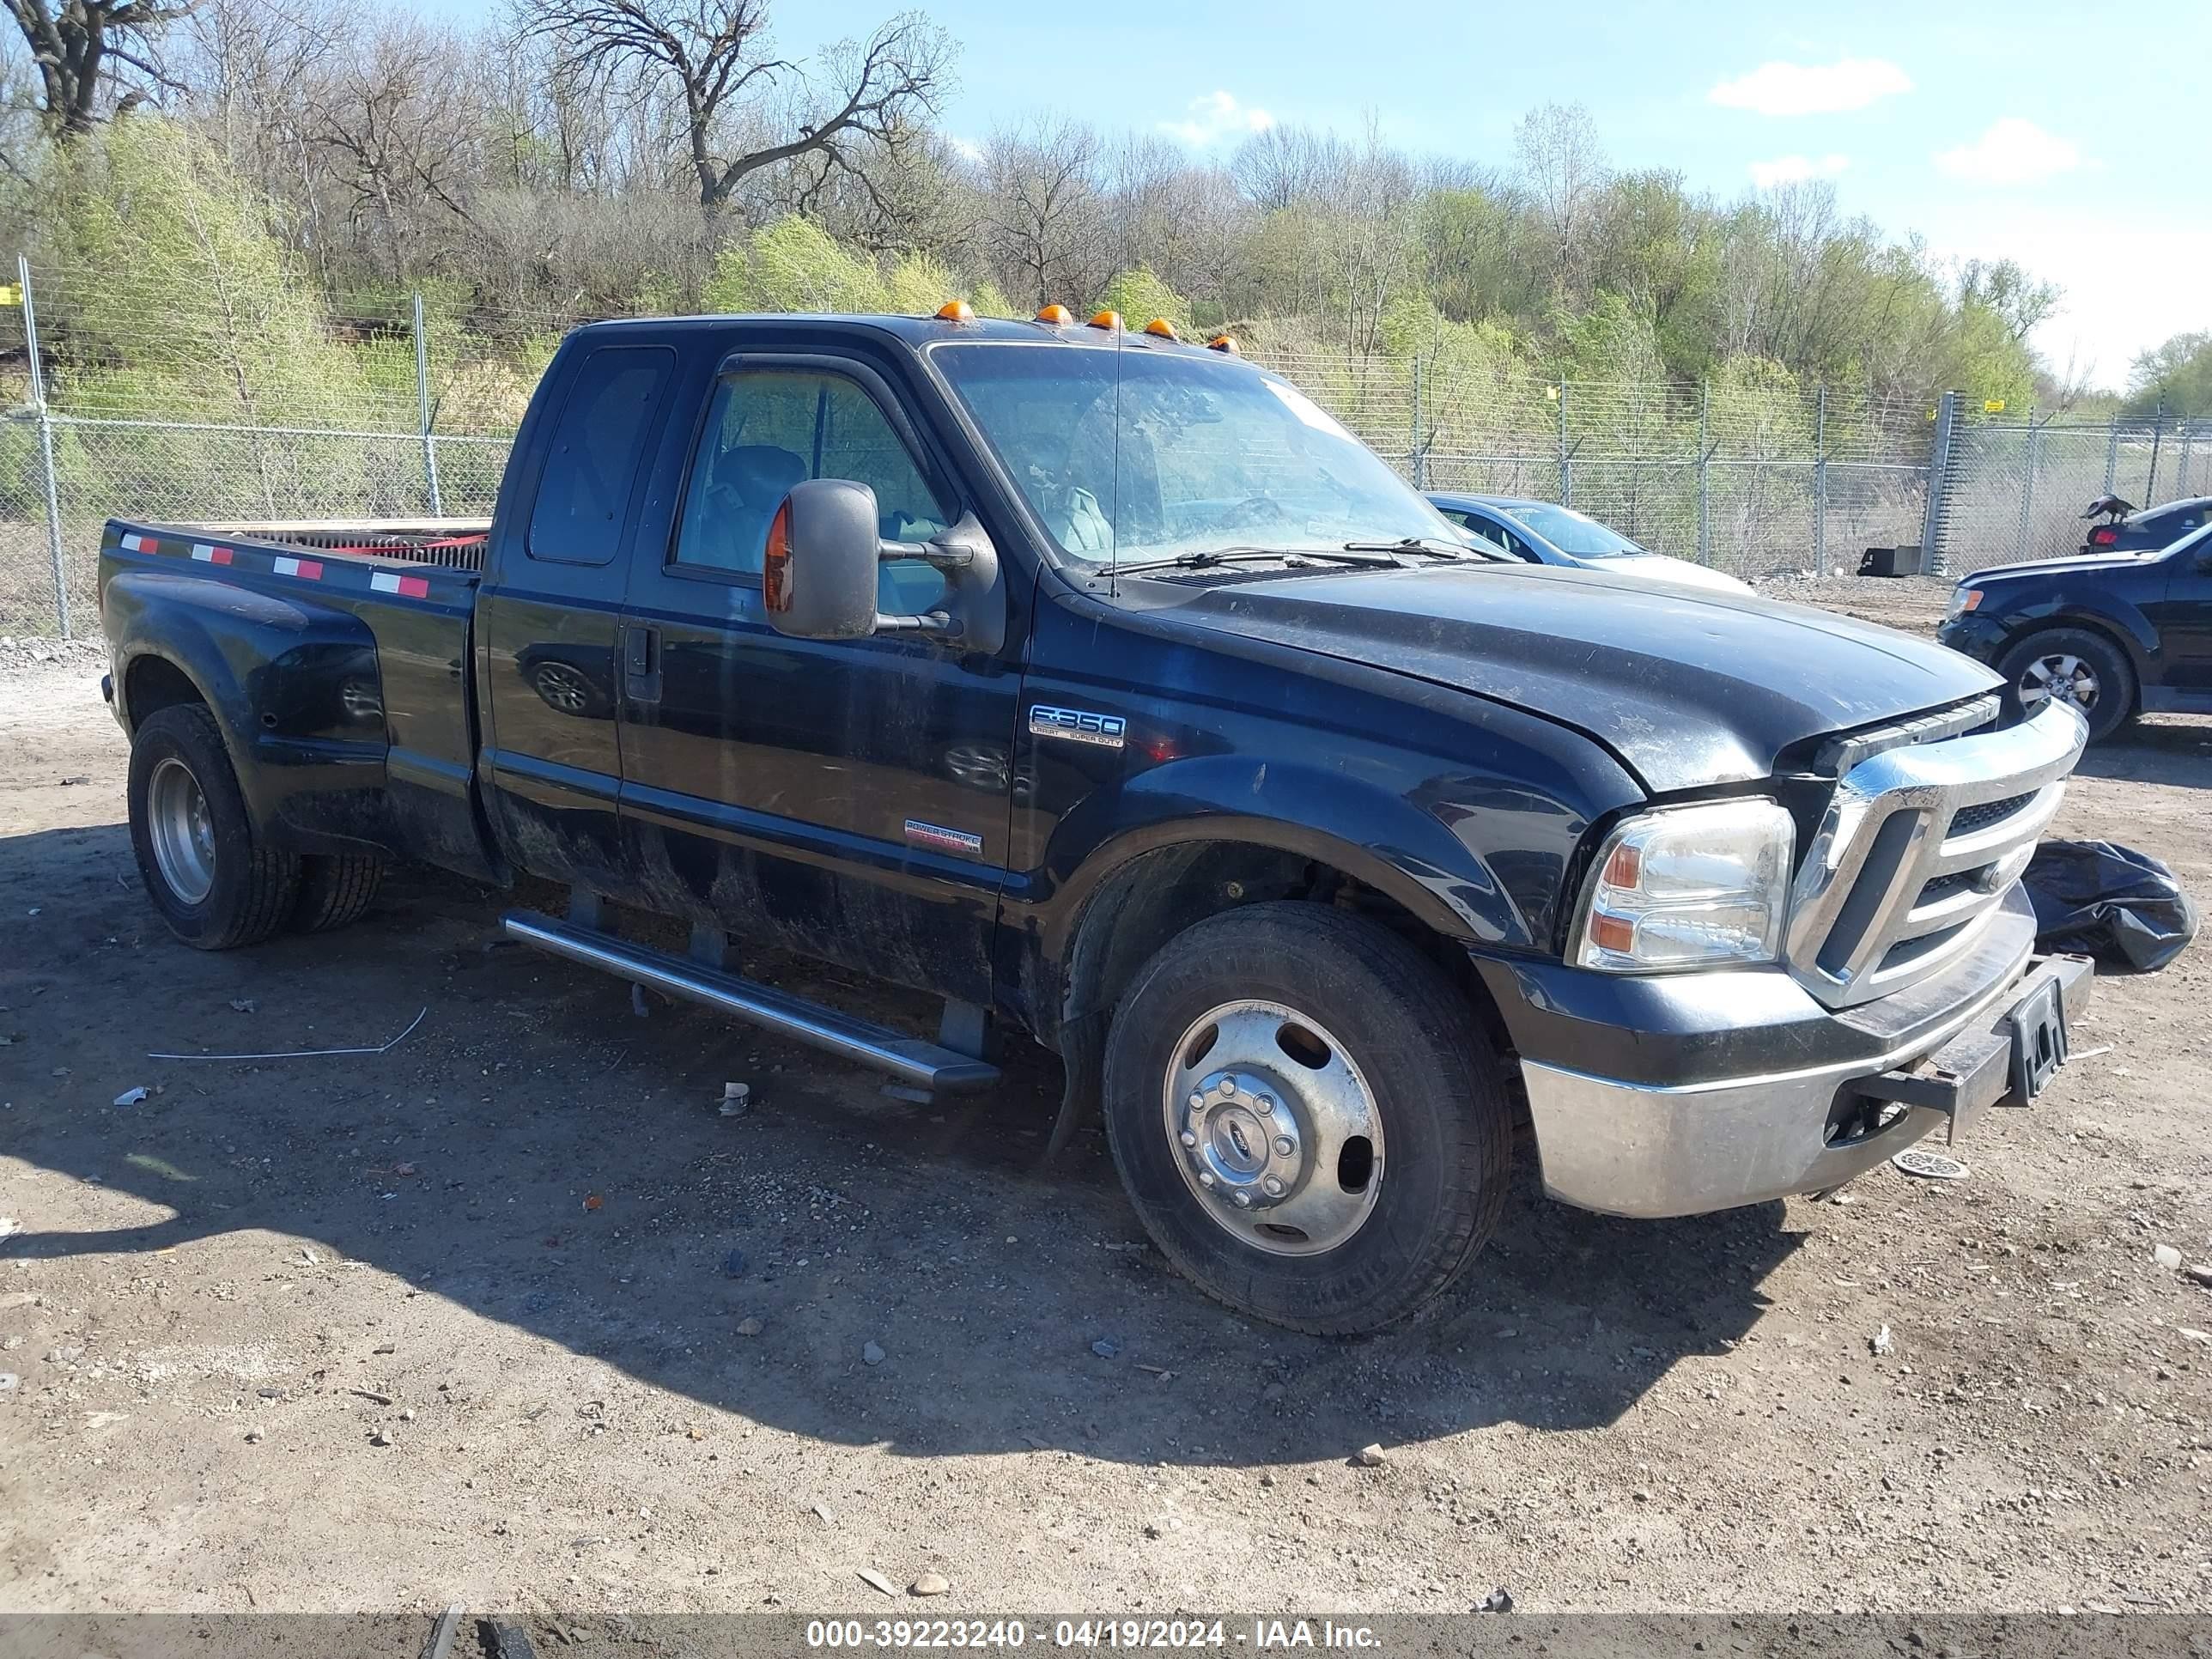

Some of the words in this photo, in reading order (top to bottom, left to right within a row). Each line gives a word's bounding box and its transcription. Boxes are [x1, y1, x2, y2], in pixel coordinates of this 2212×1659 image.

[1031, 707, 1123, 737] F-350
[1032, 726, 1059, 736] LARIAT
[1069, 732, 1097, 742] SUPER
[1098, 737, 1121, 746] DUTY
